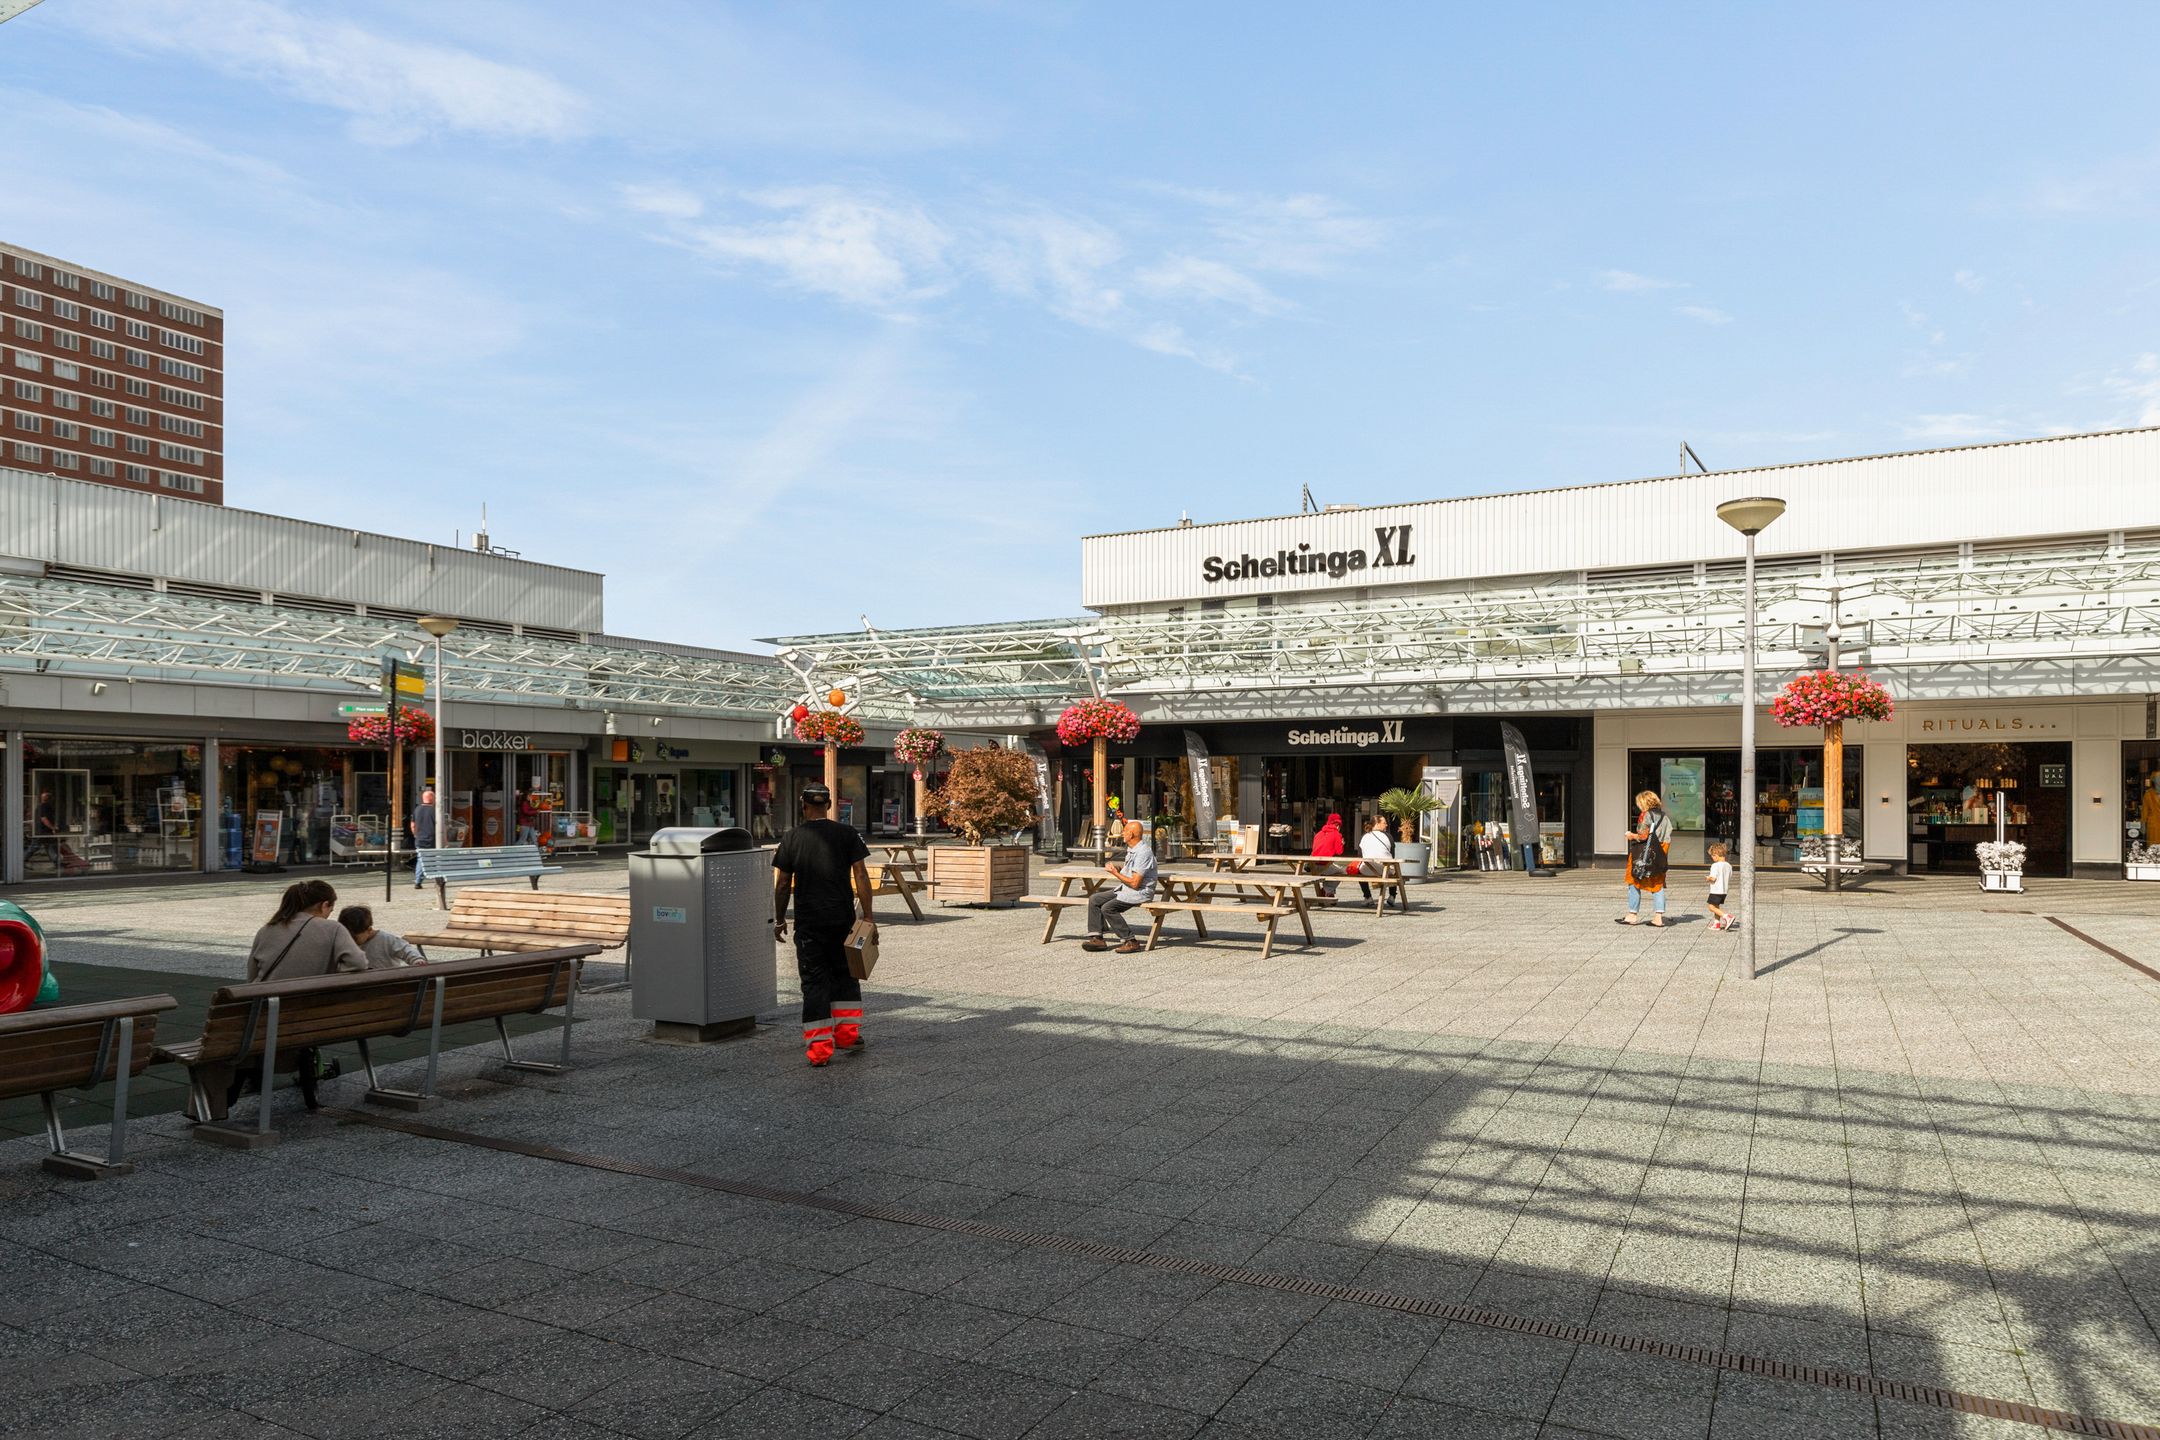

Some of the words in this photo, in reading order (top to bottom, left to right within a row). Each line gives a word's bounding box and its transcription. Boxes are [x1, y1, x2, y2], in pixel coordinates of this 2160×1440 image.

[1203, 542, 1368, 582] Scheltinga
[1372, 524, 1415, 568] XL
[461, 729, 530, 749] blokker
[1288, 726, 1379, 747] Scheltinga
[1381, 720, 1405, 743] XL
